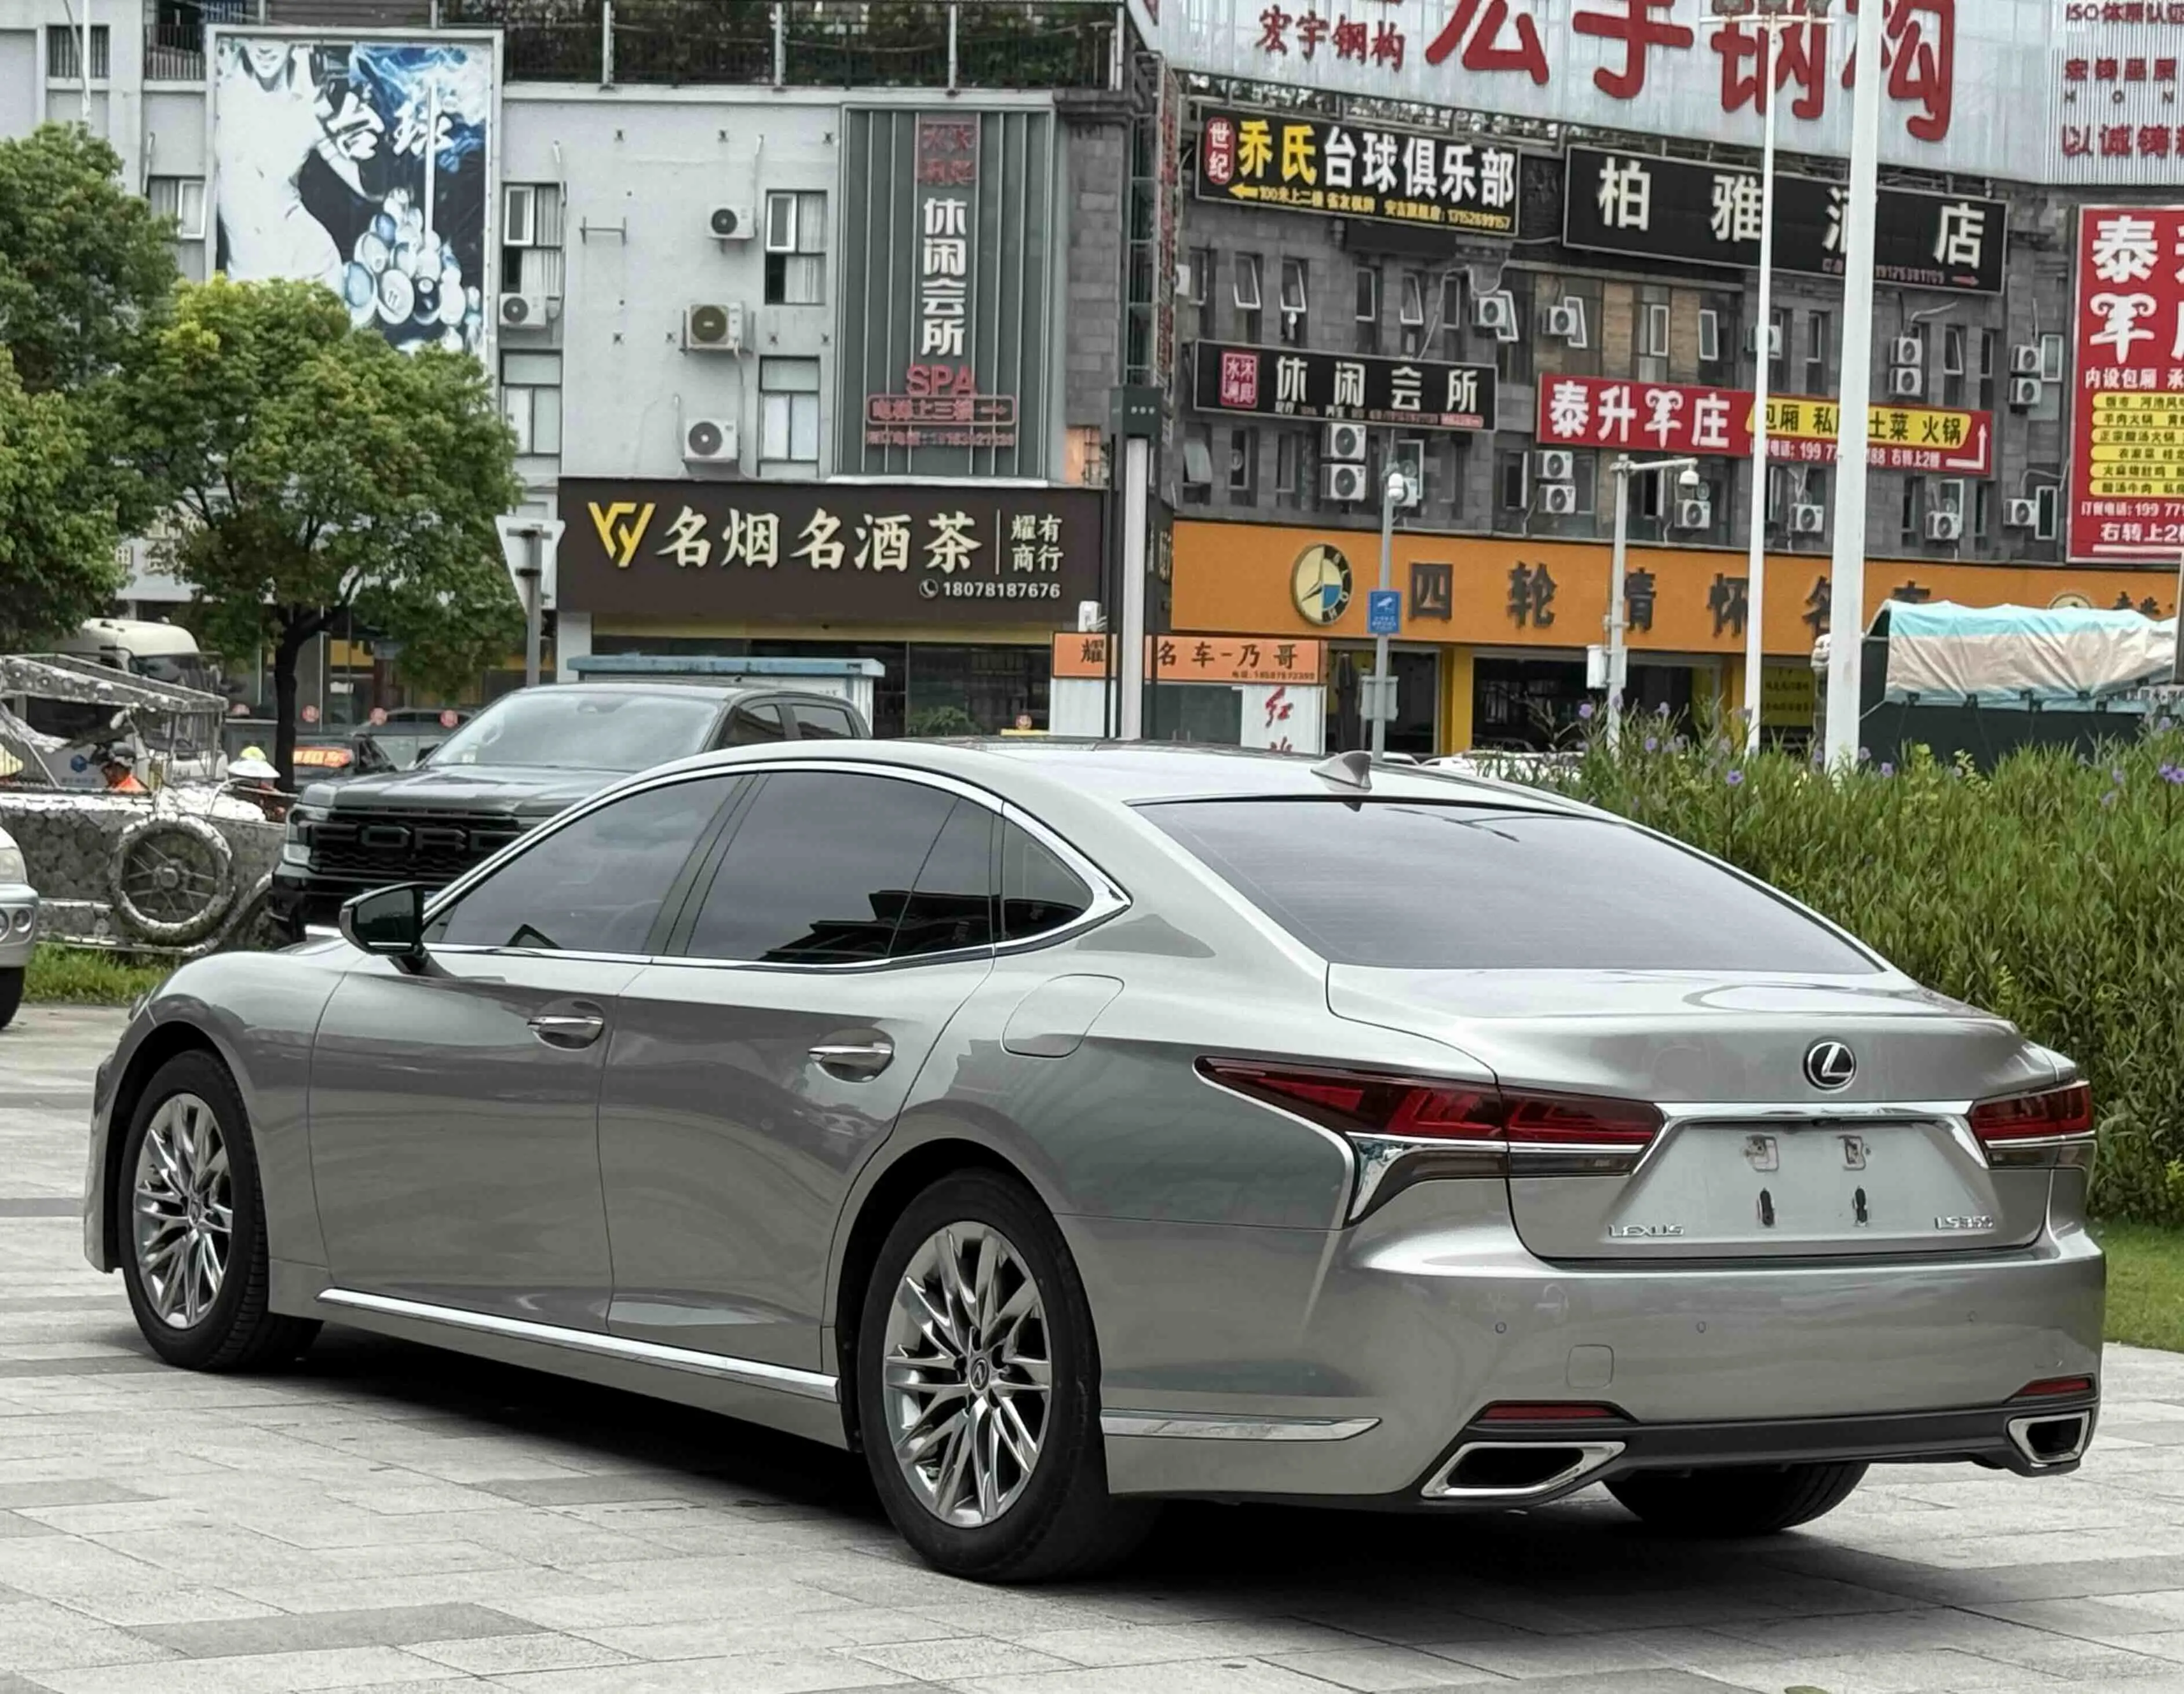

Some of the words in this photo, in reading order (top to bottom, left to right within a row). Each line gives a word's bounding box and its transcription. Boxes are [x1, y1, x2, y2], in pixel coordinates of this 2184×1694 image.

[1255, 4, 1405, 73] 宏宇钢构
[1208, 121, 1230, 179] 世纪
[2062, 123, 2184, 159] 以诚铸
[1237, 119, 1514, 208] 乔氏台球俱乐部
[2092, 215, 2184, 283] 泰
[921, 197, 967, 356] 休闲会所
[906, 364, 977, 397] SPA
[1276, 355, 1478, 413] 休闲会所
[2086, 367, 2157, 389] 内设包厢
[1922, 415, 1962, 445] 火锅
[1800, 441, 1822, 461] 199
[655, 504, 983, 575] 名烟名酒茶
[1010, 514, 1062, 542] 耀有
[2100, 522, 2184, 543] 右转上2
[1011, 544, 1064, 572] 商行
[943, 581, 1061, 599] 18078187676
[1080, 637, 1297, 670] 耀名车-乃哥
[1608, 1224, 1684, 1238] LEXUS
